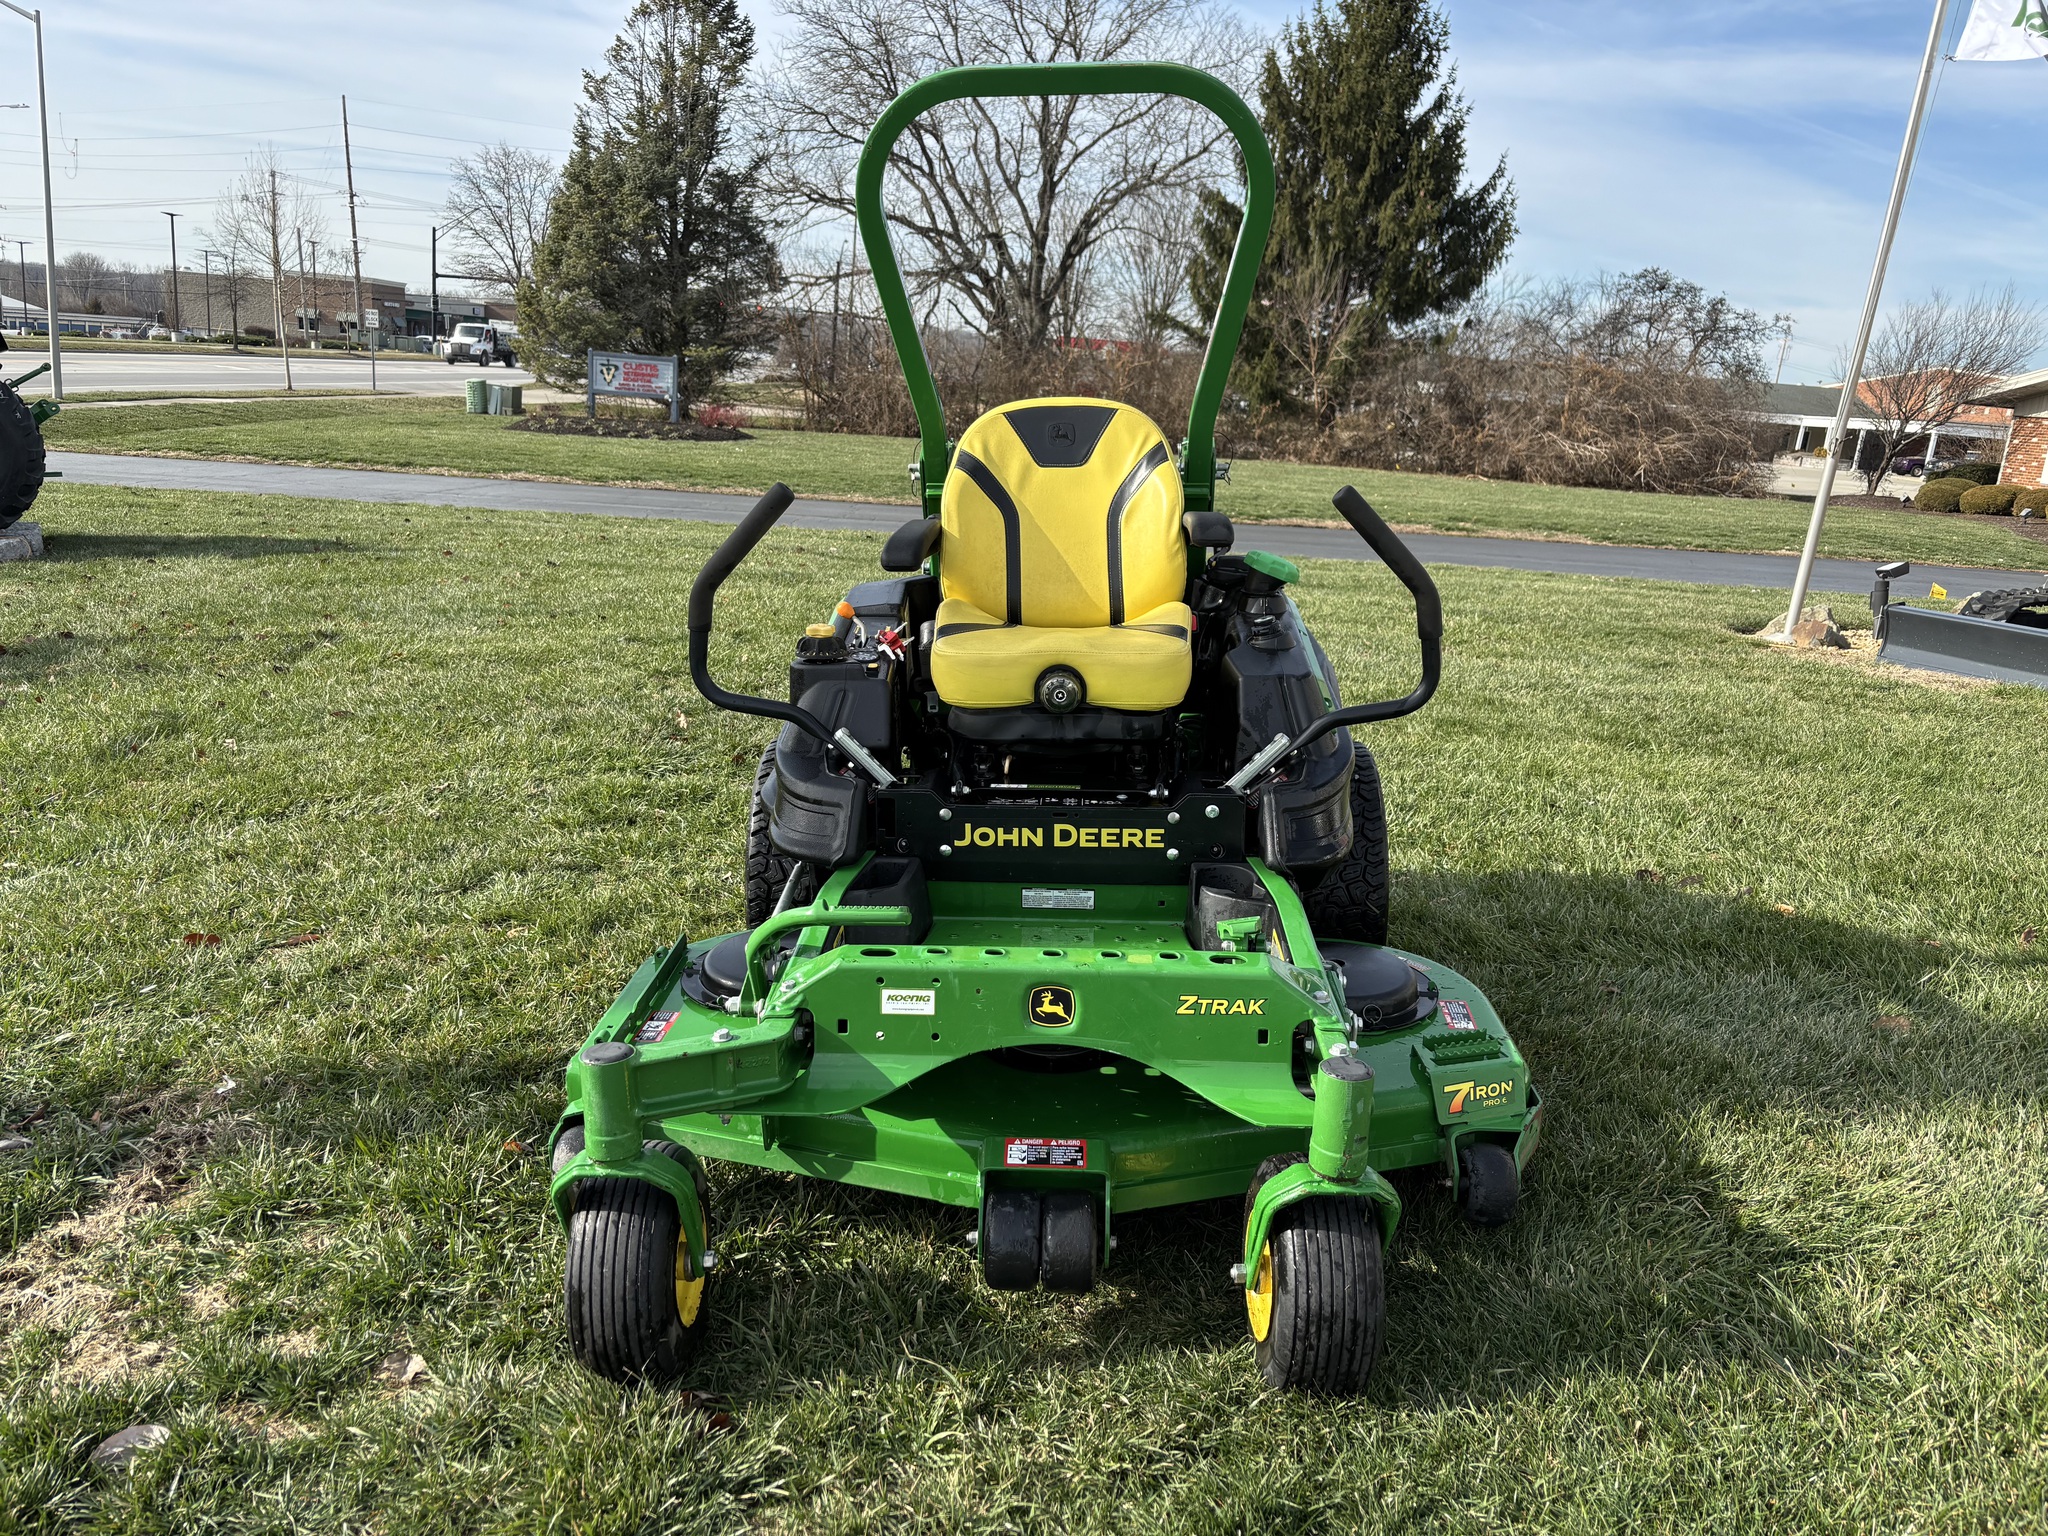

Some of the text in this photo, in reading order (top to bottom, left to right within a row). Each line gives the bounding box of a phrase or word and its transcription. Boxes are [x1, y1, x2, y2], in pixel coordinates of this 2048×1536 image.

[622, 362, 659, 373] CUSTIS
[954, 823, 1165, 848] JOHN DEERE
[1176, 995, 1266, 1015] ZTRAK
[1483, 1098, 1500, 1107] PRO
